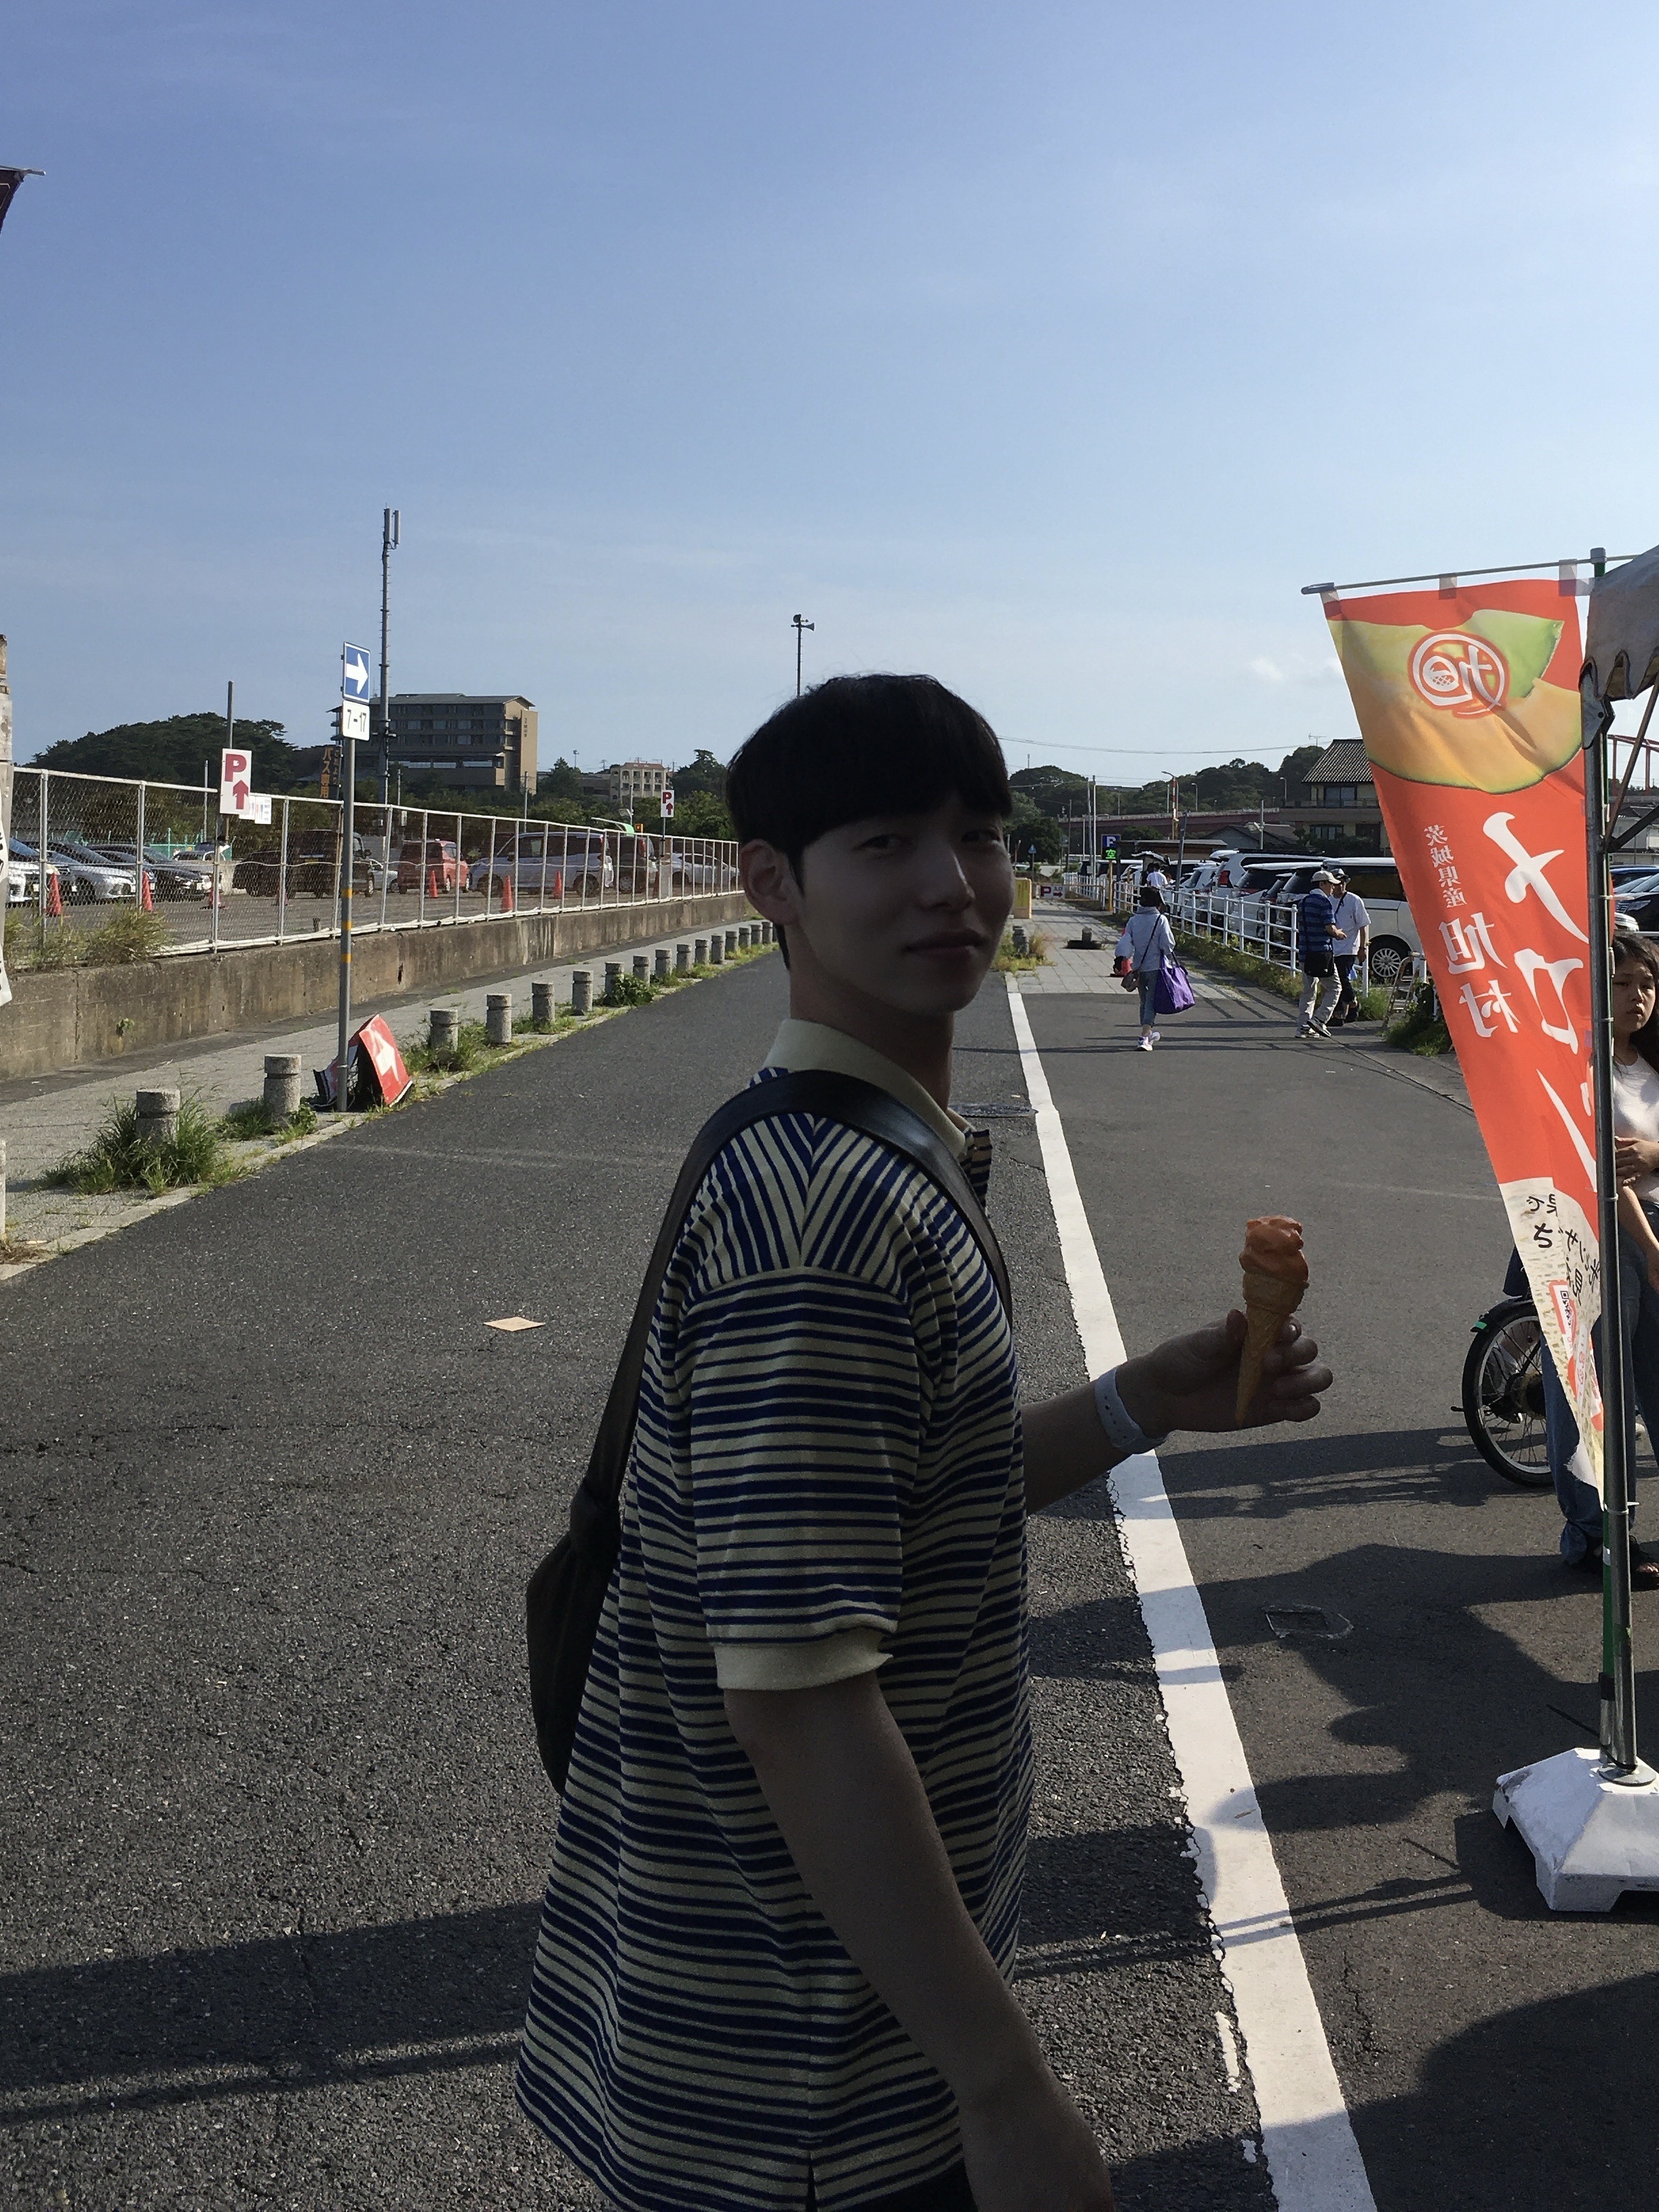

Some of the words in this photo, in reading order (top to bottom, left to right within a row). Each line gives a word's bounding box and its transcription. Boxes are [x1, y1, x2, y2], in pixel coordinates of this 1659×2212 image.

[347, 709, 367, 732] 7-17
[225, 753, 247, 783] P
[662, 791, 672, 804] P
[1106, 836, 1116, 847] P
[1041, 886, 1052, 897] P
